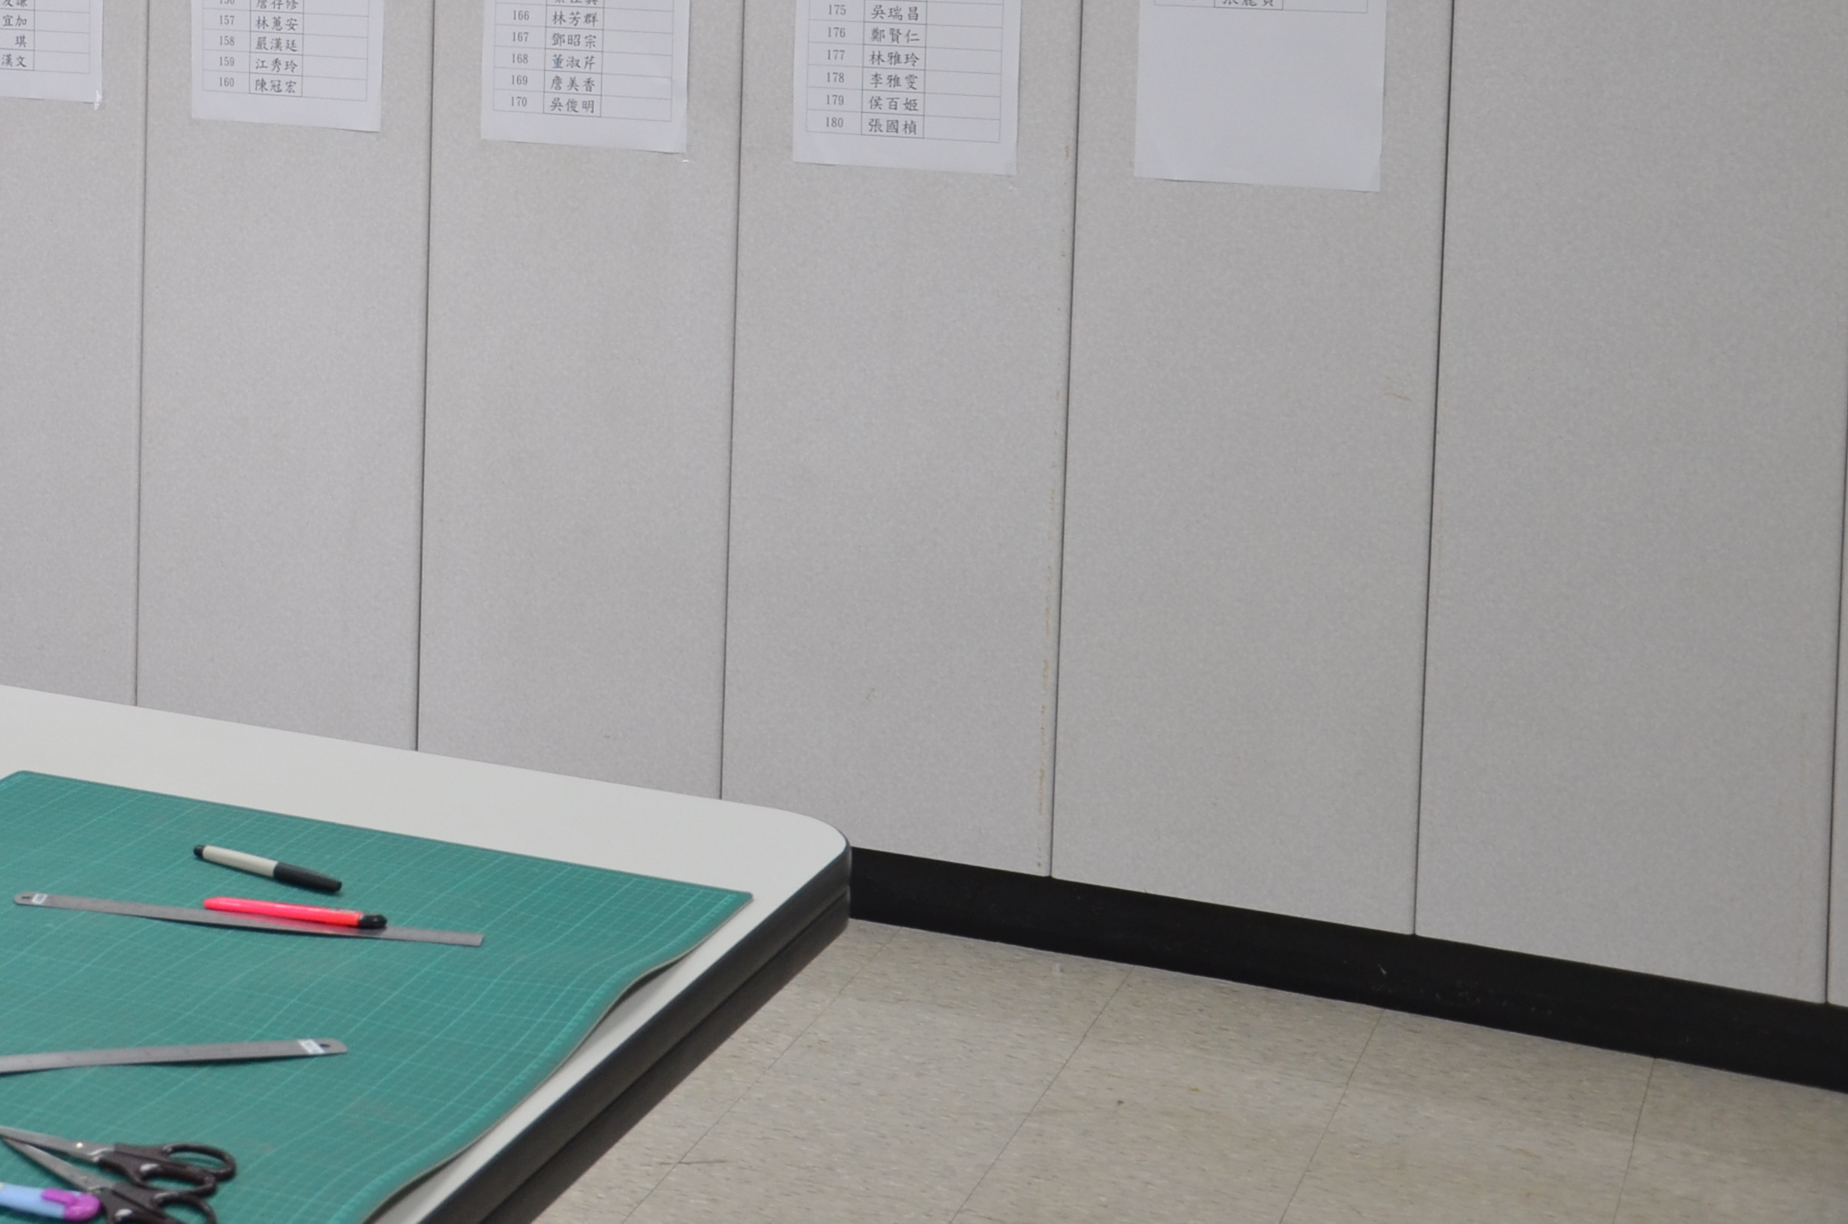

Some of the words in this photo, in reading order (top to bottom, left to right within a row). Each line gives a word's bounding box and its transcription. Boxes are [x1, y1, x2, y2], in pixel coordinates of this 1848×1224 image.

[828, 4, 847, 15] 175
[871, 5, 920, 21] 吳瑞昌
[827, 27, 847, 38] 176
[870, 28, 920, 43] 鄭賢仁
[826, 49, 846, 60] 177
[870, 51, 920, 66] 林雅玲
[826, 72, 845, 83] 178
[870, 73, 919, 90] 李雅雯
[510, 96, 528, 107] 170
[549, 97, 595, 113] 吳俊明
[826, 94, 845, 105] 179
[868, 96, 919, 111] 侯百姬
[825, 117, 845, 128] 180
